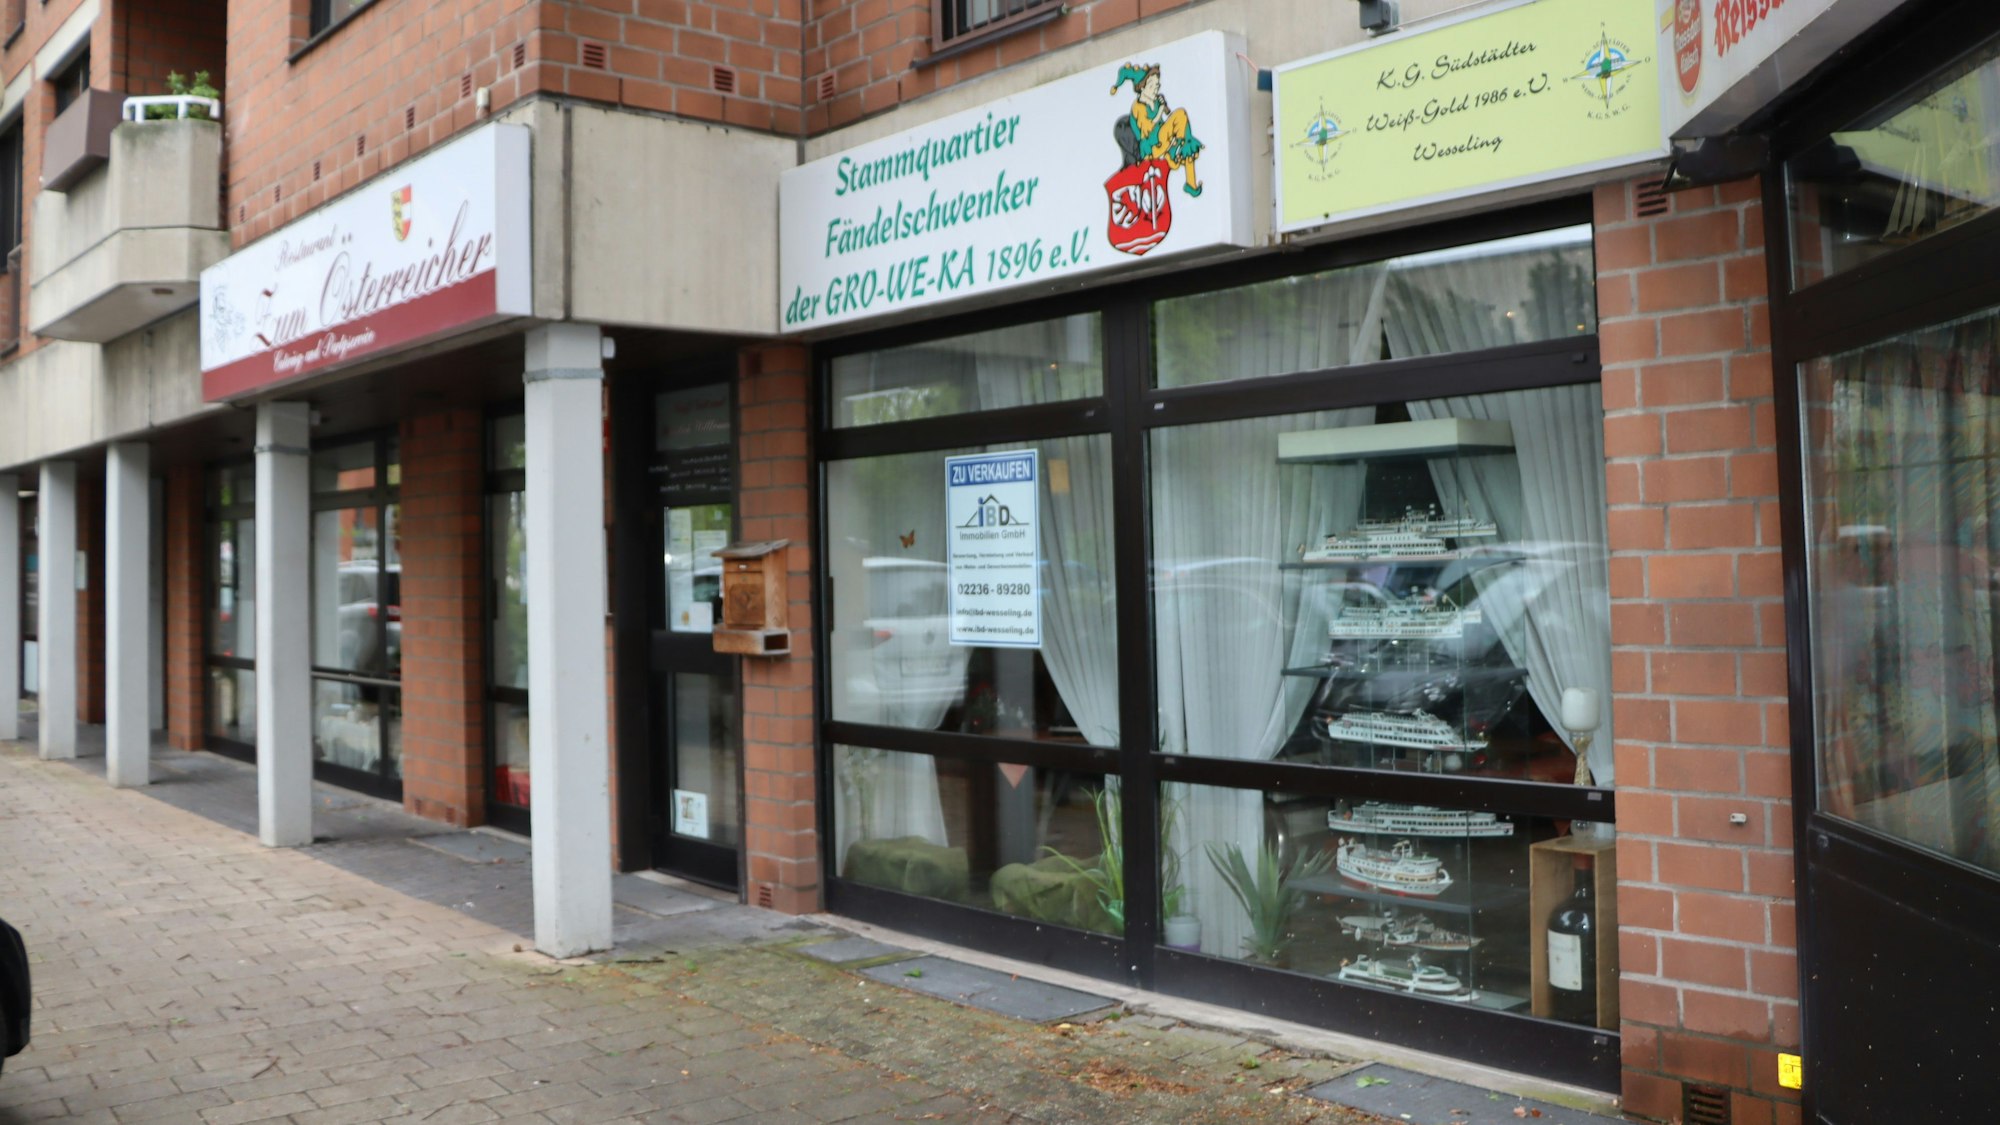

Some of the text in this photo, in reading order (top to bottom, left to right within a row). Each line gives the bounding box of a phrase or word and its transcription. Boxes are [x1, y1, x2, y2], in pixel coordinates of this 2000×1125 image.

[1376, 40, 1536, 92] K.G. Südstädter
[1366, 98, 1469, 134] Weiß-Gold
[1474, 86, 1508, 109] 1986
[835, 112, 1020, 197] Stammquartier
[1413, 134, 1503, 162] Wesseling
[824, 172, 1039, 258] Fändelschwenker
[253, 199, 493, 348] Zum Österreicher
[785, 226, 1091, 326] der GRO-WE-KA 1896 e.V.
[952, 459, 1030, 484] ZU VERKAUFEN
[959, 529, 1026, 542] Immobilien GmbH
